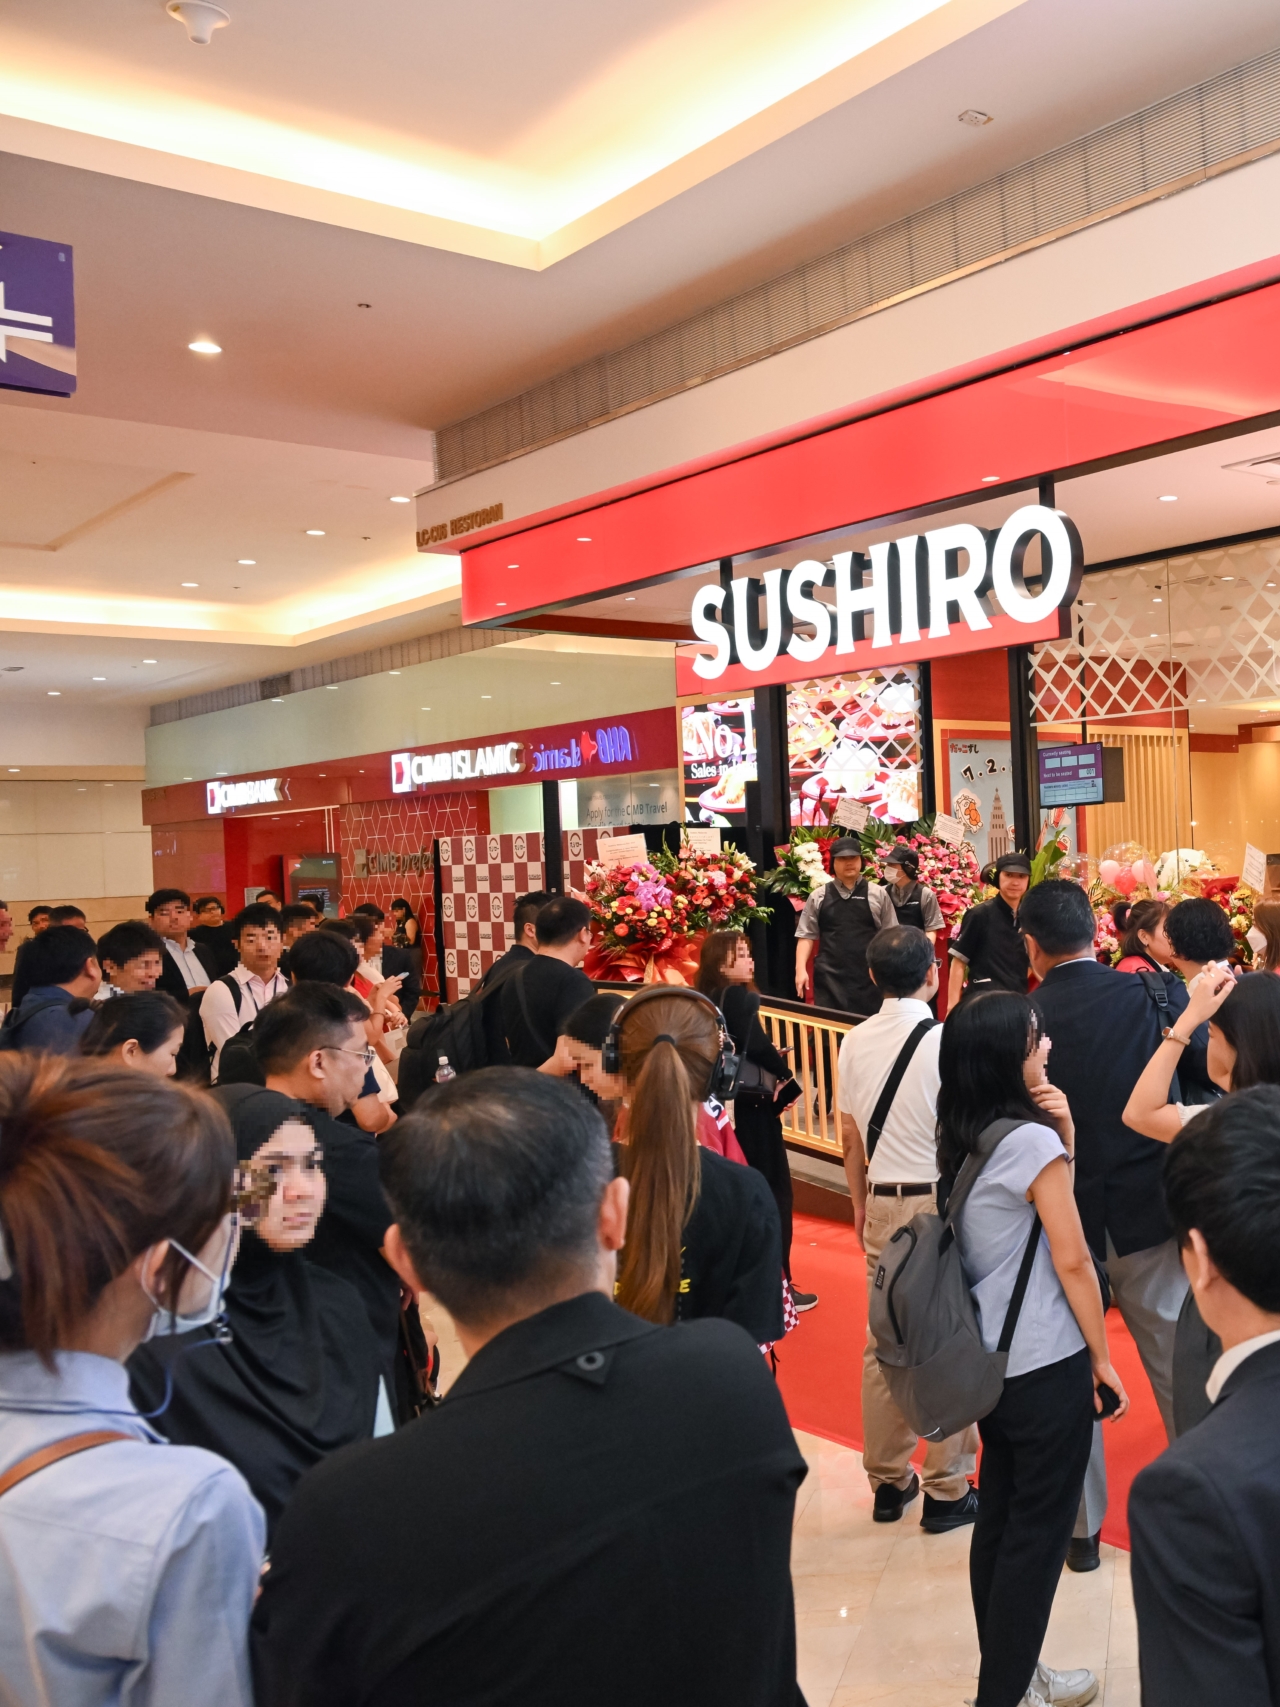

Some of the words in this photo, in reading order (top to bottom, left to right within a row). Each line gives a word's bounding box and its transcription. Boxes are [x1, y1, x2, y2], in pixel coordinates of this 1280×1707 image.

[450, 503, 503, 536] RESTORAN
[691, 504, 1073, 680] SUSHIRO
[411, 753, 451, 785] CIMB
[451, 742, 519, 780] ISLAMIC
[691, 761, 717, 778] Sales
[586, 807, 604, 821] Apply
[604, 806, 615, 817] for
[615, 804, 625, 816] the
[626, 803, 644, 816] CIMB
[646, 801, 668, 814] Travel
[368, 851, 399, 873] CIMB
